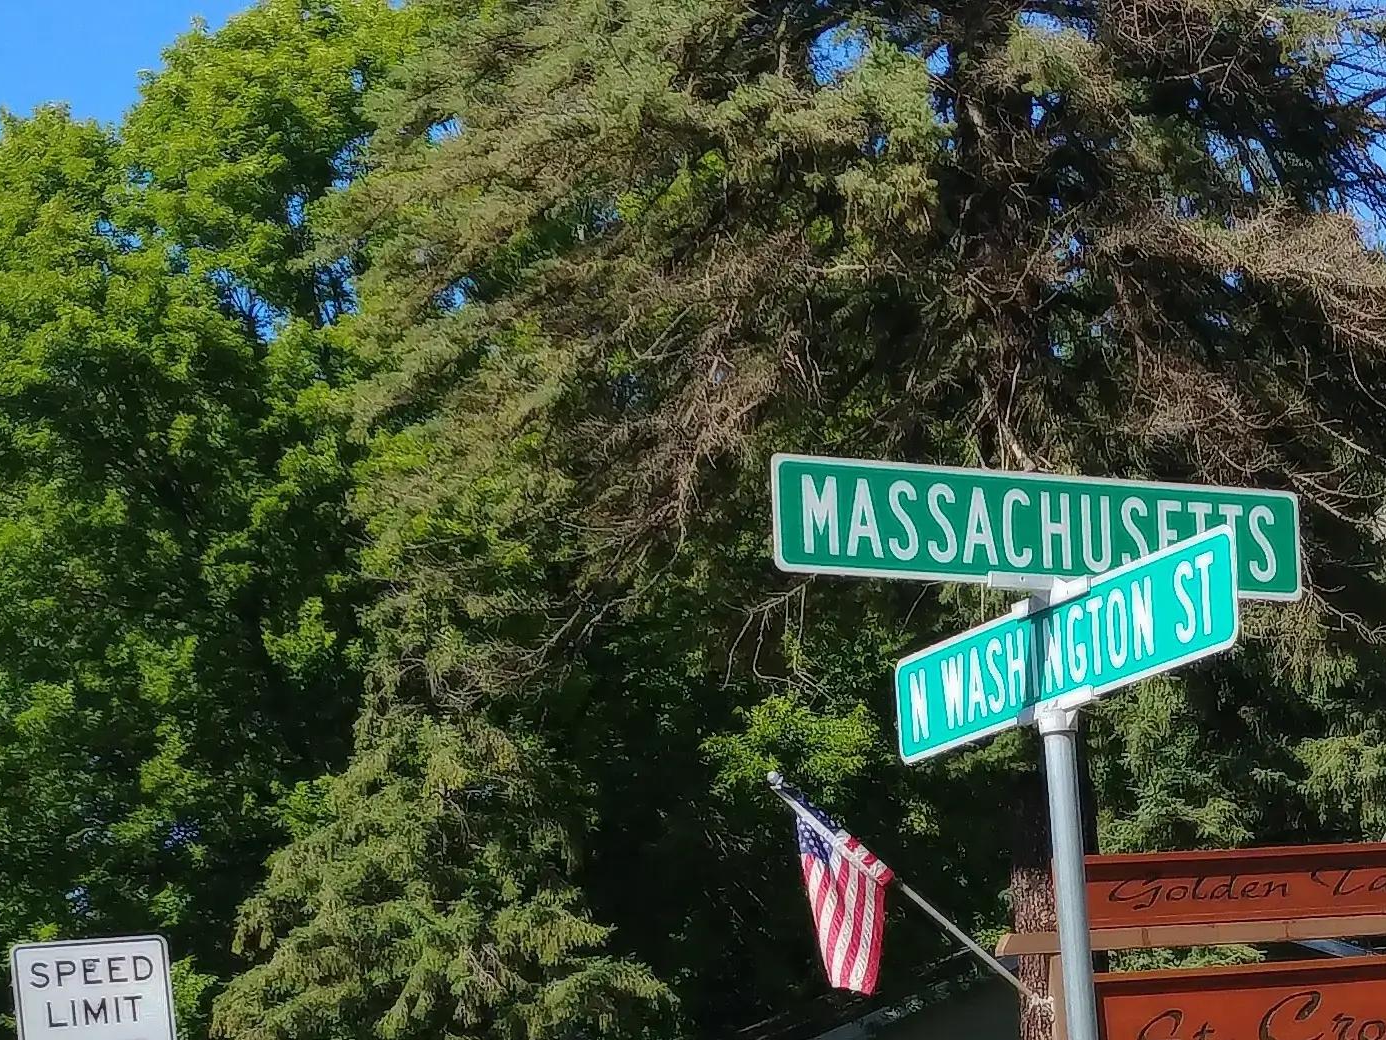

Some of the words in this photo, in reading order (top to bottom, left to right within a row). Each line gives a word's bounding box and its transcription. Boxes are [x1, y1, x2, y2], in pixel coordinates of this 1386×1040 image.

[908, 667, 930, 743] N
[940, 575, 1155, 731] WASHINGTON
[1173, 550, 1214, 644] ST
[1108, 873, 1290, 910] Golden
[29, 955, 154, 989] SPEED
[46, 994, 143, 1028] LIMIT
